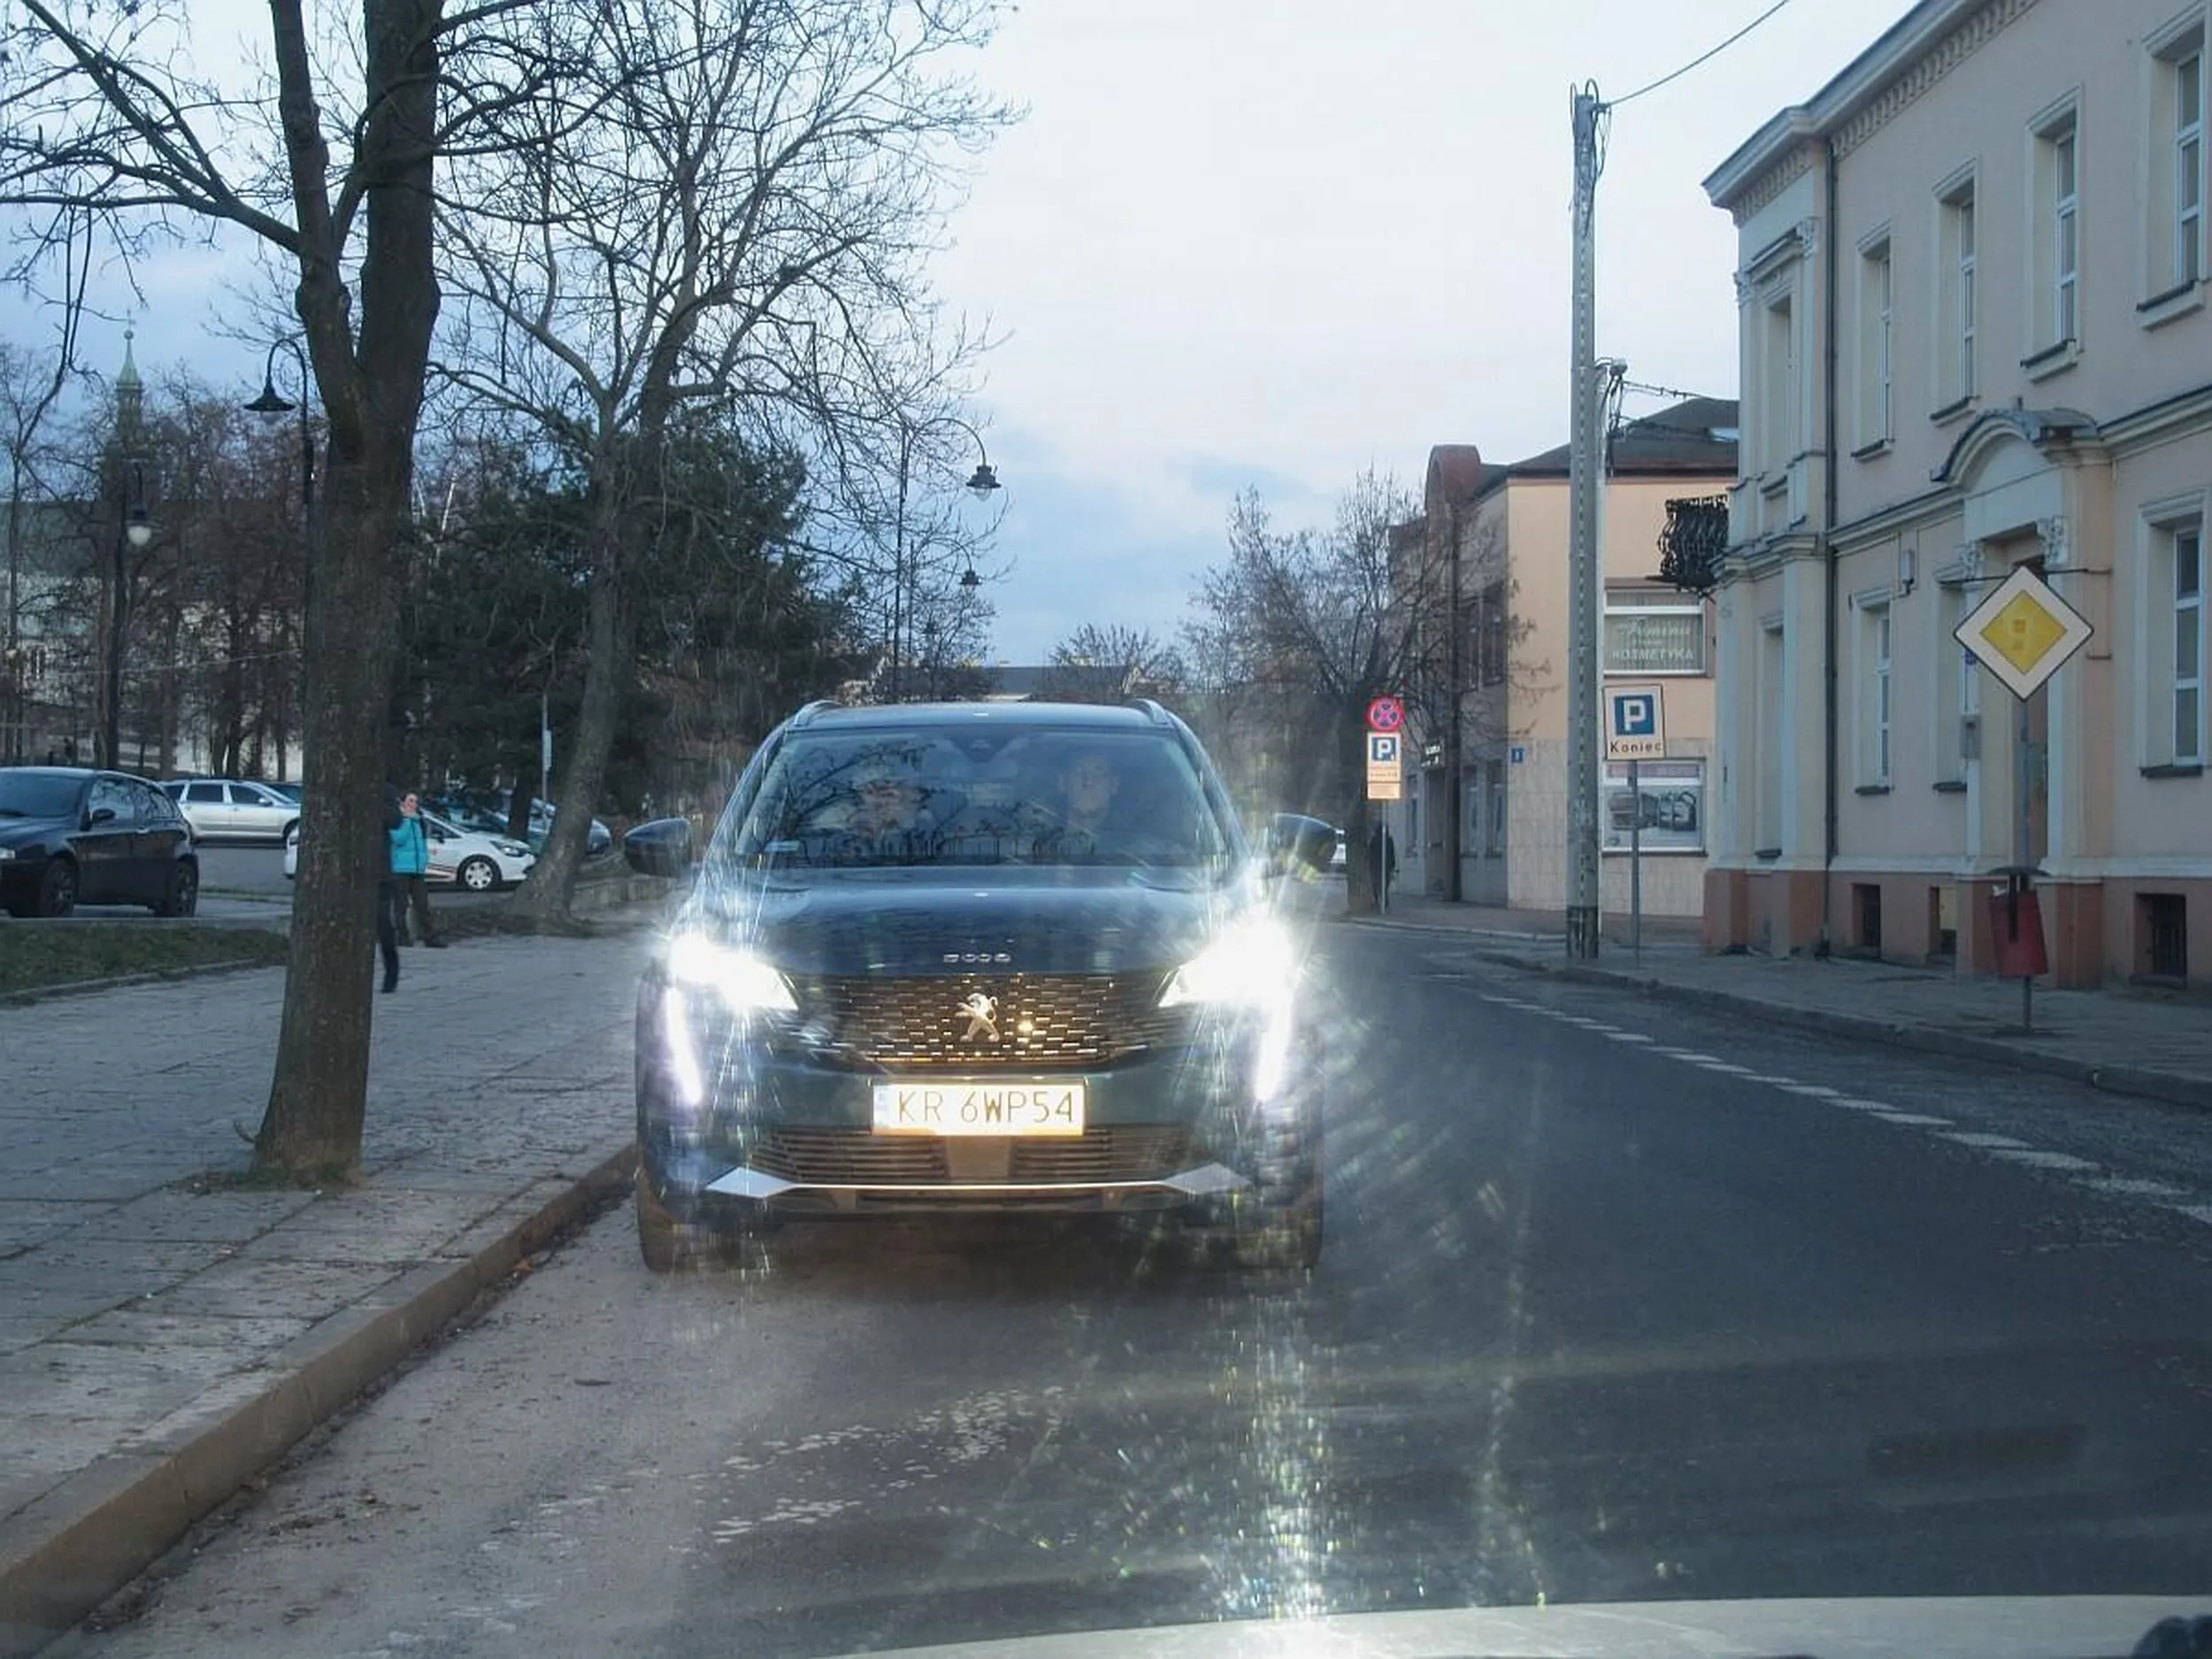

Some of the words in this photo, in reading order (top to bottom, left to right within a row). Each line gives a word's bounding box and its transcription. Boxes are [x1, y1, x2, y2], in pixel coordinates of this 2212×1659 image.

[1624, 700, 1646, 731] P
[1378, 739, 1391, 758] P
[1610, 741, 1662, 752] Koniec
[899, 1091, 943, 1123] KR
[961, 1091, 1072, 1123] 6WP54
